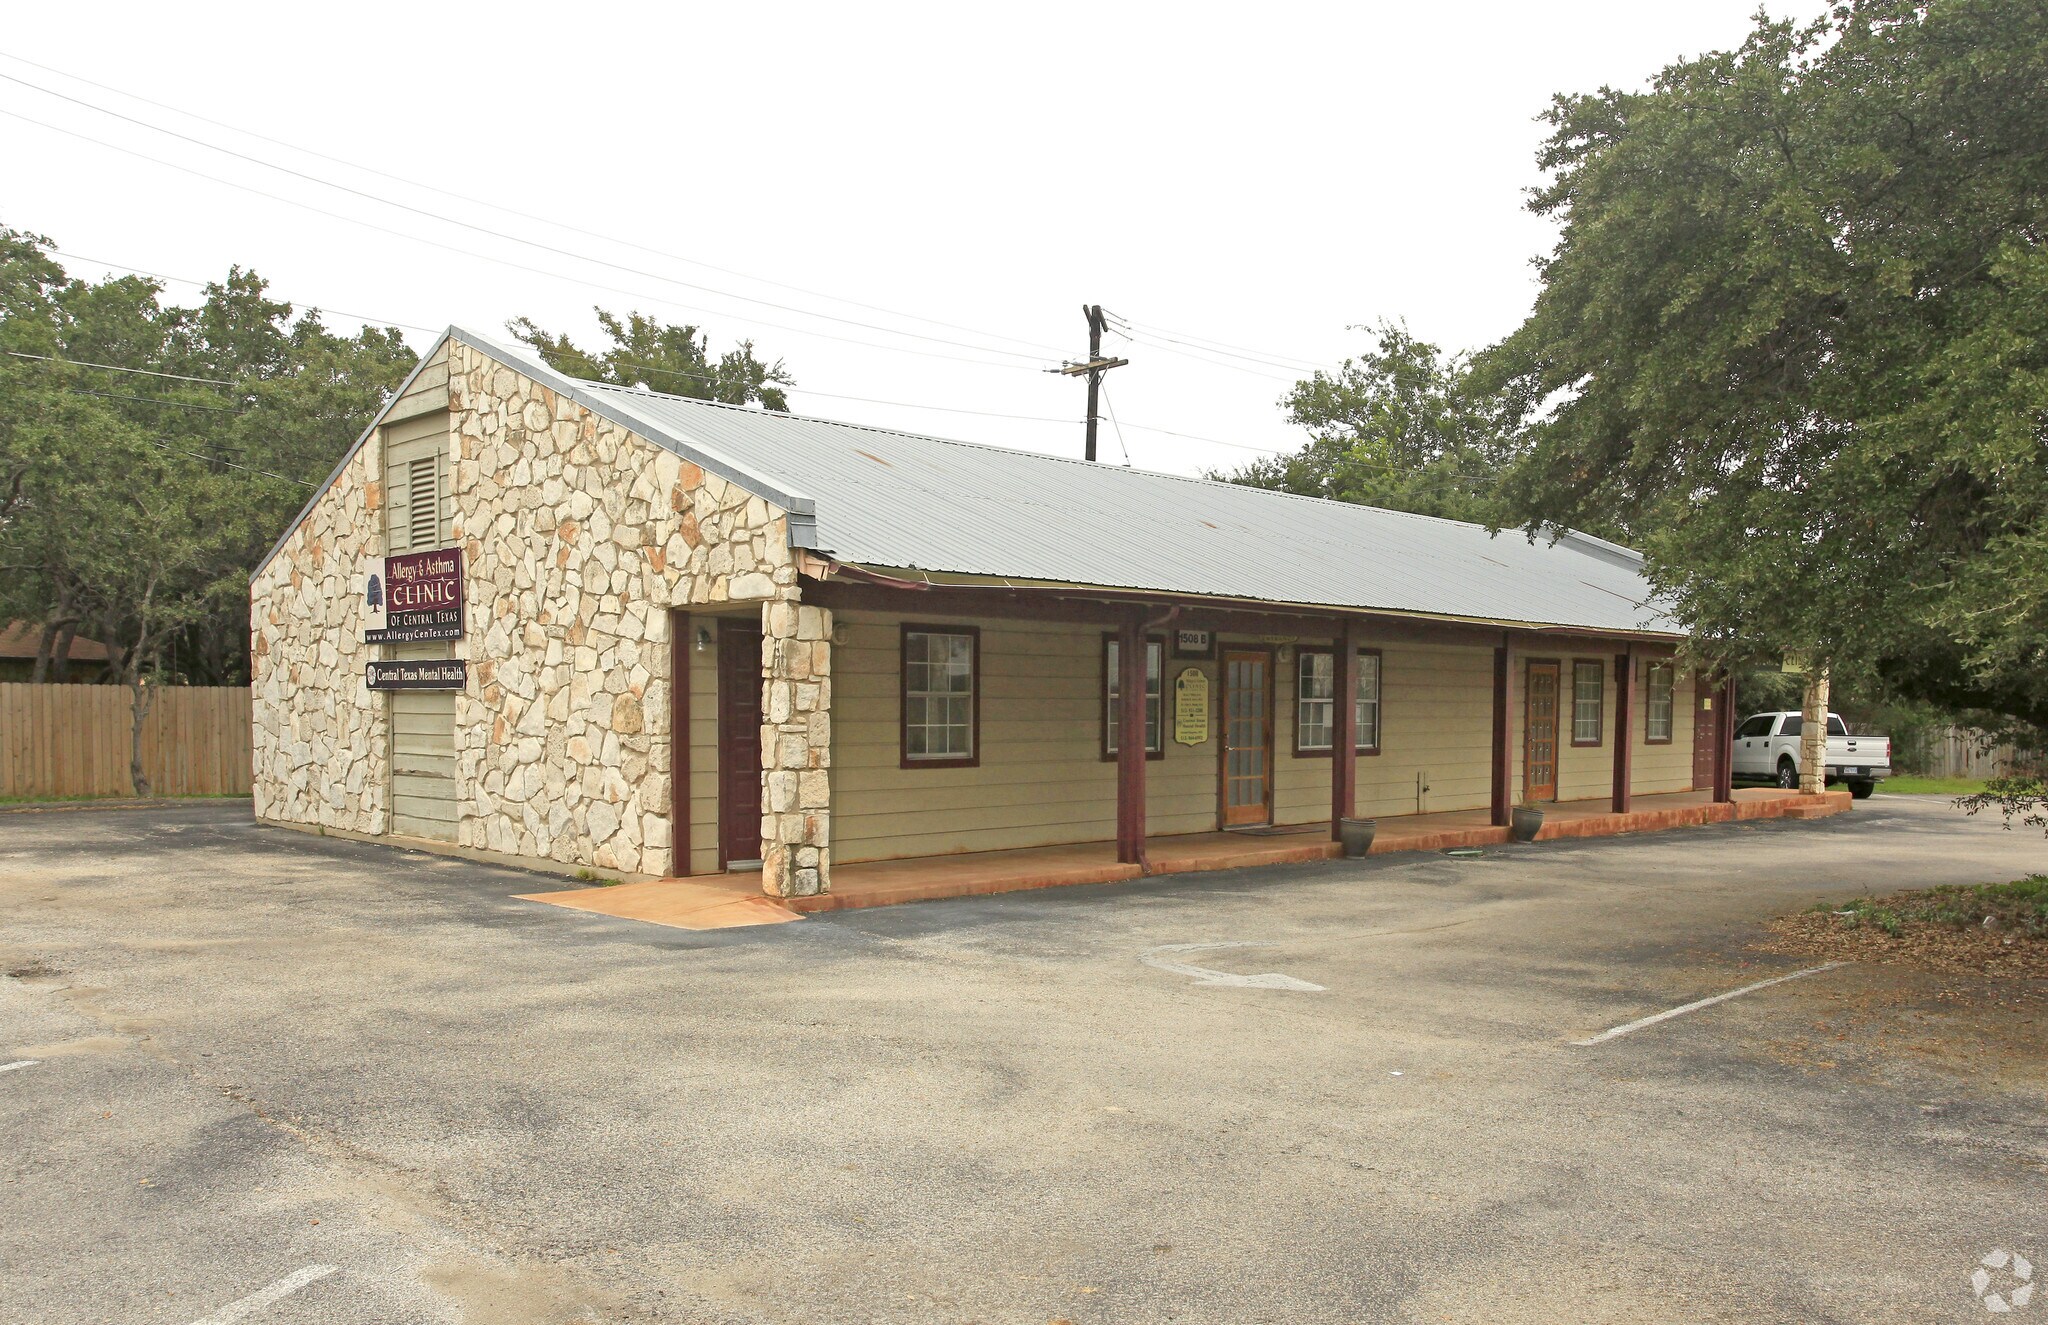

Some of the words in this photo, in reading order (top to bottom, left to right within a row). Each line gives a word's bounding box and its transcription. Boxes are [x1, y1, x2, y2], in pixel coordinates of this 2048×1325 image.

[391, 562, 416, 582] Allergy
[418, 559, 424, 577] &
[426, 556, 455, 576] Asthma
[393, 580, 455, 606] CLINIC
[403, 612, 433, 626] CENTRAL
[436, 611, 458, 624] TEXAS
[366, 628, 460, 641] www.AllergyCenTex.com
[1179, 633, 1199, 644] 1508
[1200, 634, 1207, 644] B
[377, 668, 400, 681] Central
[400, 667, 418, 681] Texas
[419, 667, 440, 681] Mental
[441, 665, 463, 681] Health
